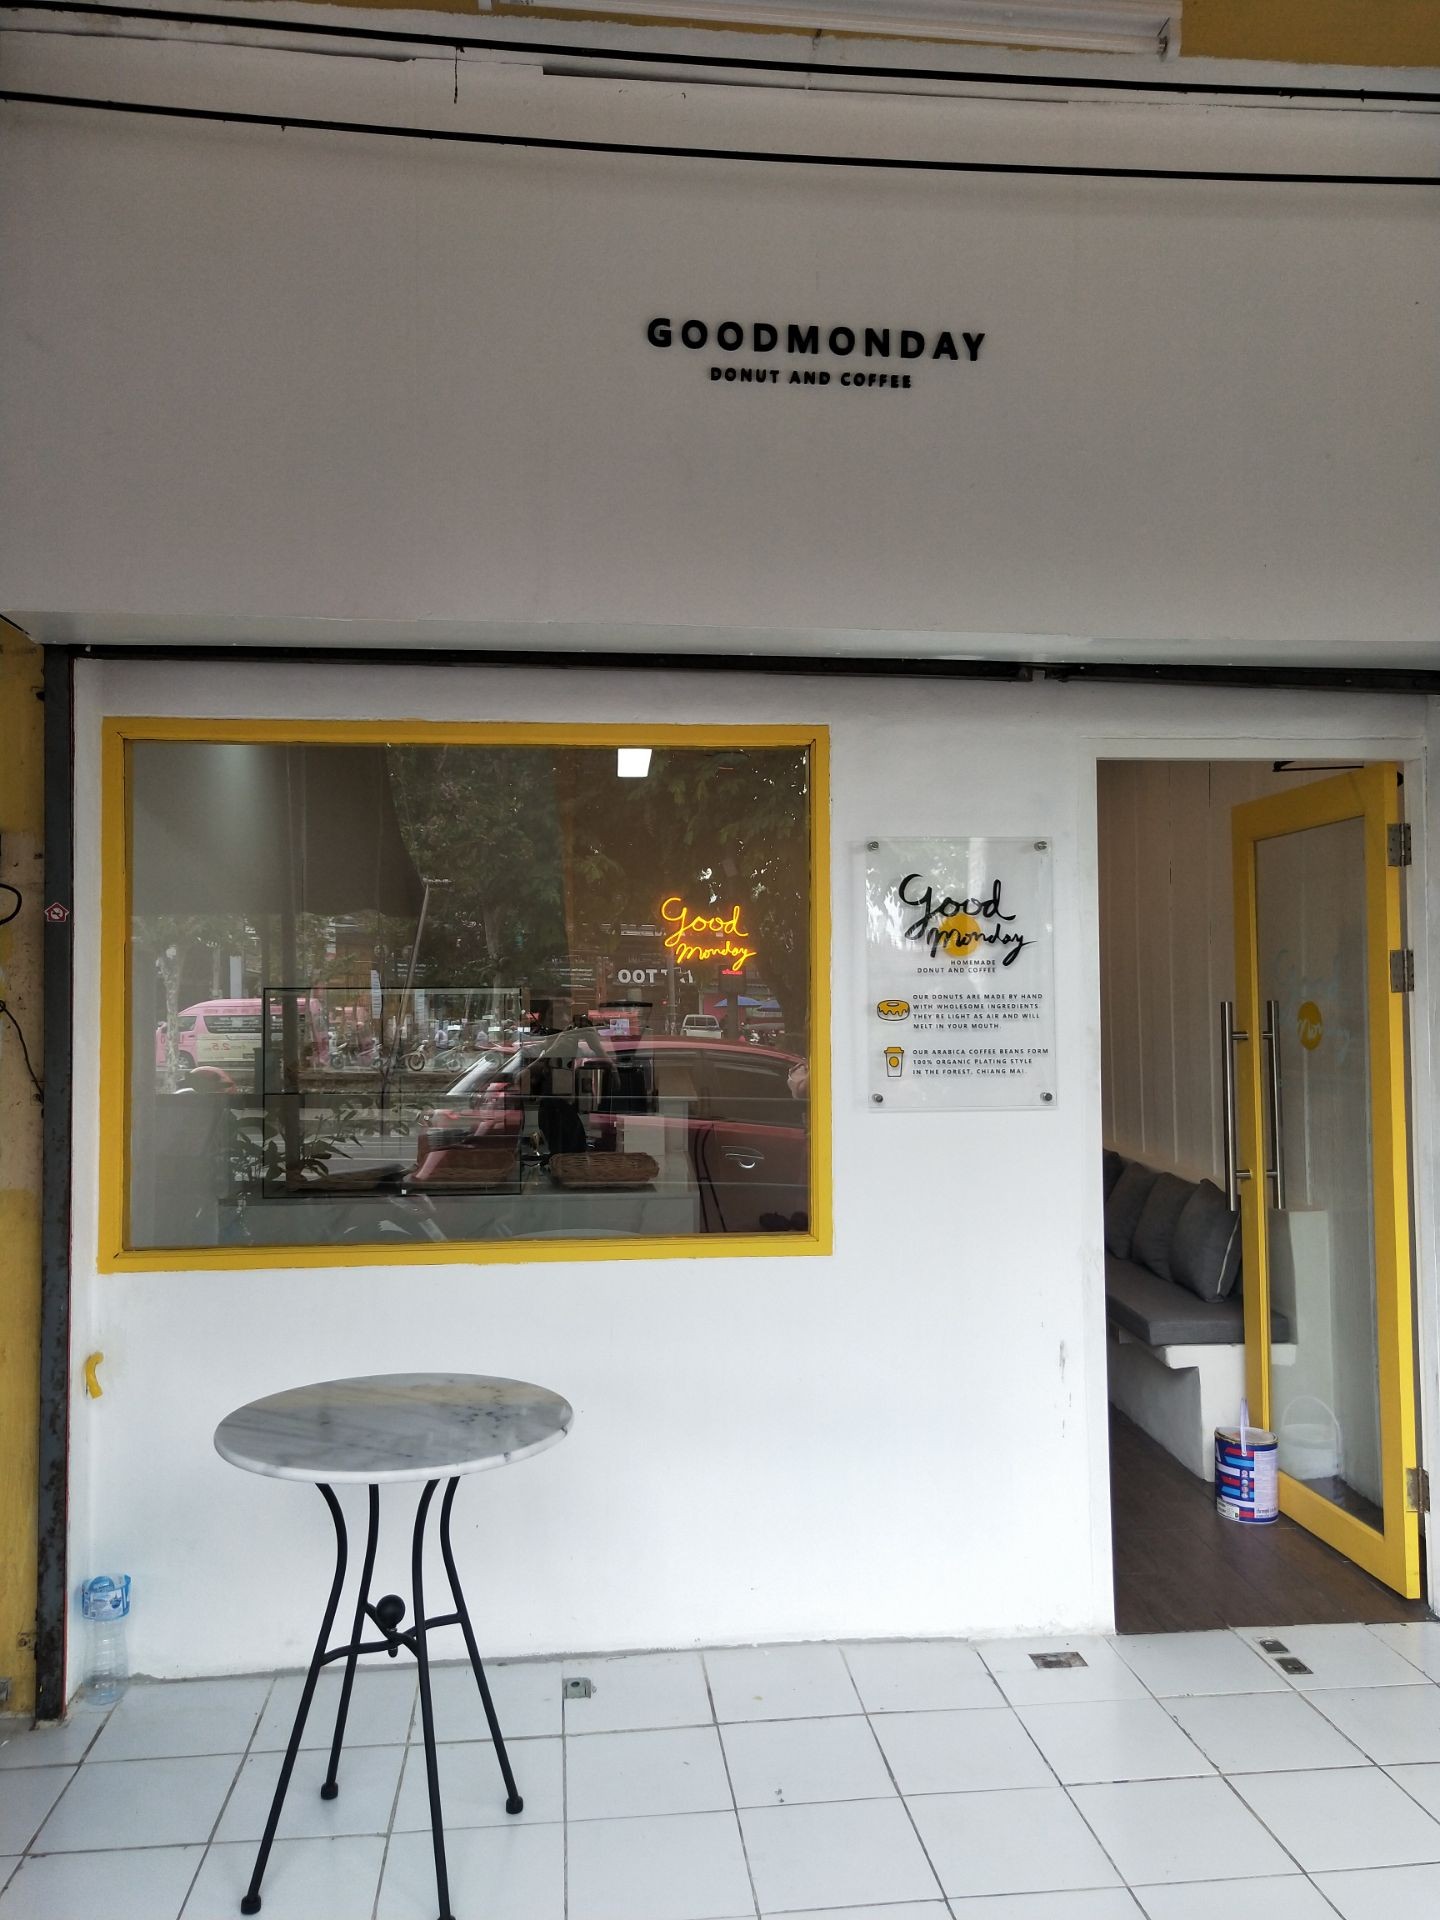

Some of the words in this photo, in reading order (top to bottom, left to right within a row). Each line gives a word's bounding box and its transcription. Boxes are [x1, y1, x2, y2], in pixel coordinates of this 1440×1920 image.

[647, 318, 985, 361] GOODMONDAY
[711, 367, 779, 383] DONUT
[789, 371, 830, 385] AND
[841, 372, 911, 388] COFFEE
[661, 897, 749, 947] Good
[899, 873, 1016, 940] Good
[916, 967, 945, 975] DONUT
[947, 967, 966, 975] AND
[967, 966, 997, 974] COFFEE
[950, 959, 996, 967] HOMEMADE
